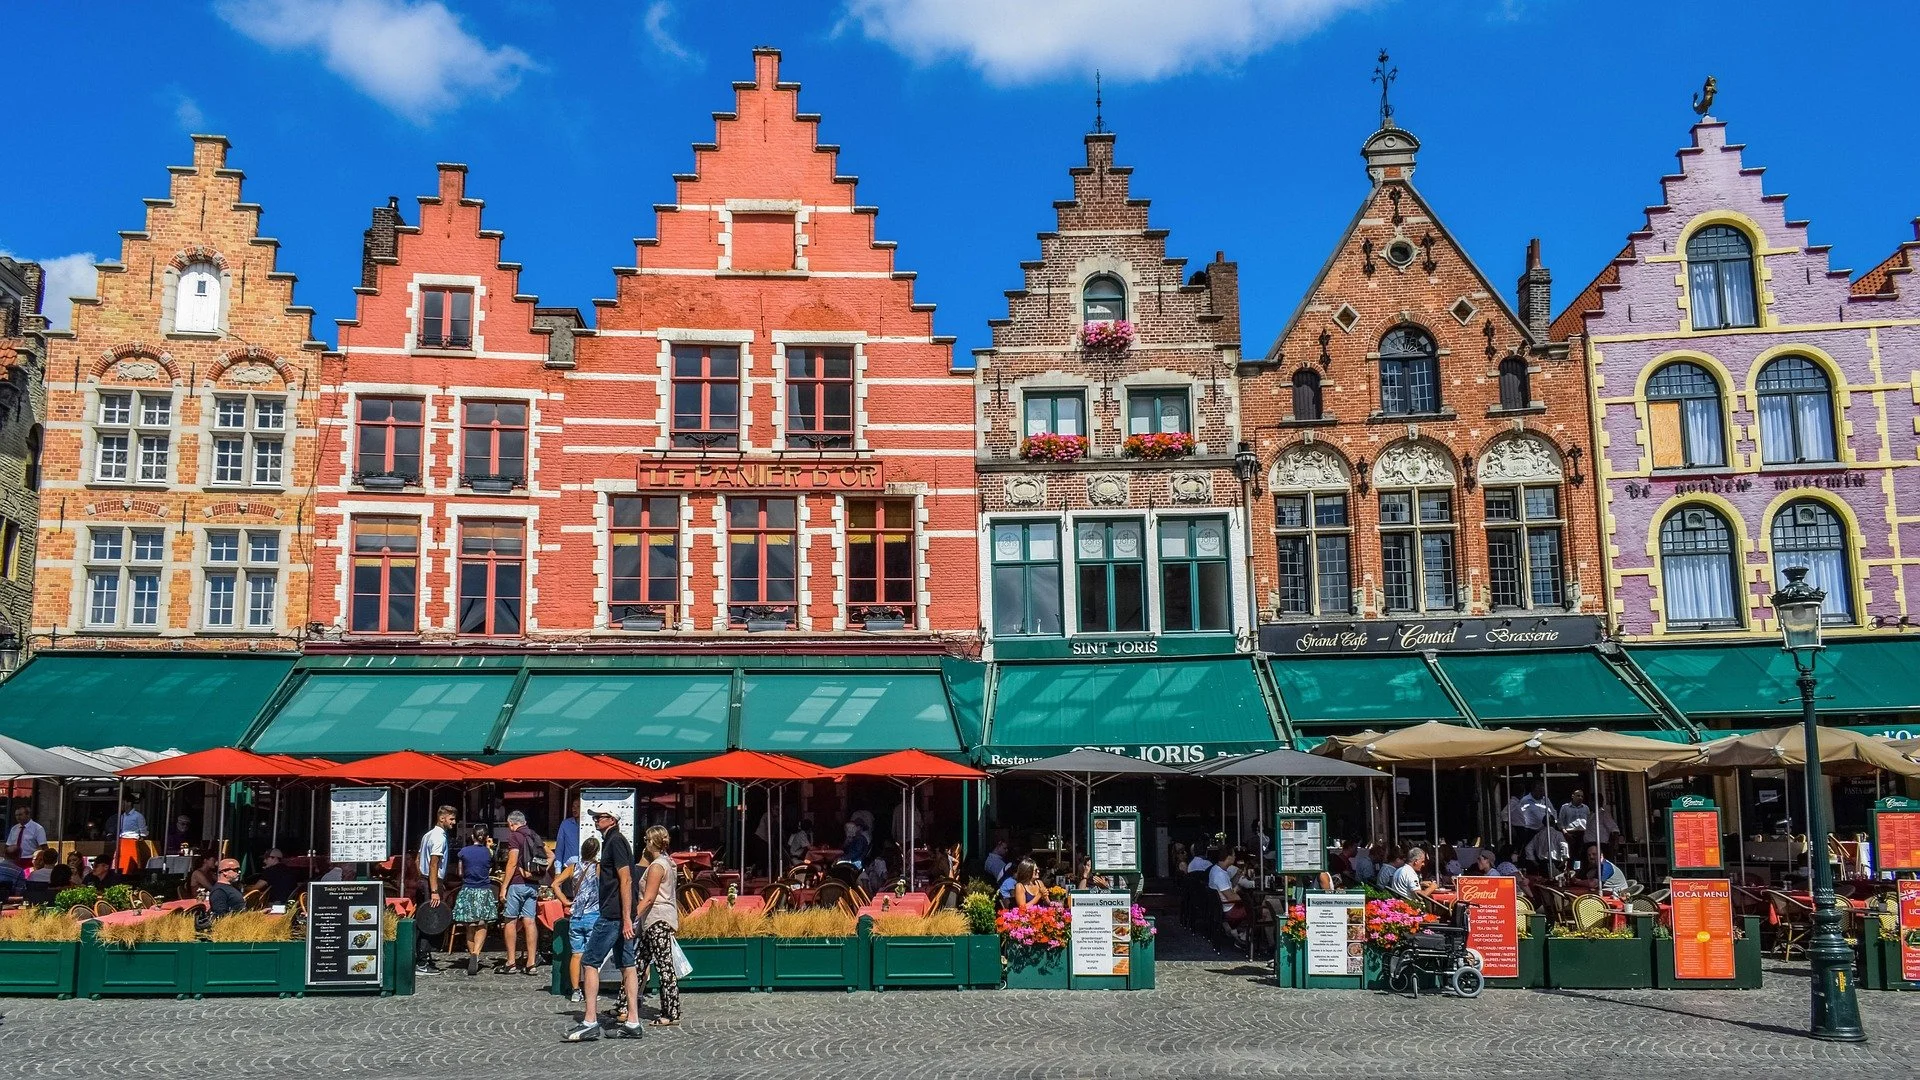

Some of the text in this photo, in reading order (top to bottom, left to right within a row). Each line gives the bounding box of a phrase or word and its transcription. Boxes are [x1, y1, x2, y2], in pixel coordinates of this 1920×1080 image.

[650, 464, 877, 487] LE PANIER D'OR
[1296, 633, 1338, 652] Grand
[1398, 624, 1458, 648] Central
[1486, 628, 1559, 642] Brasserie
[1073, 640, 1158, 655] SINT JORIS
[1682, 796, 1704, 808] Central
[1886, 798, 1908, 808] Central
[1462, 885, 1498, 902] Central
[1689, 882, 1709, 891] Central
